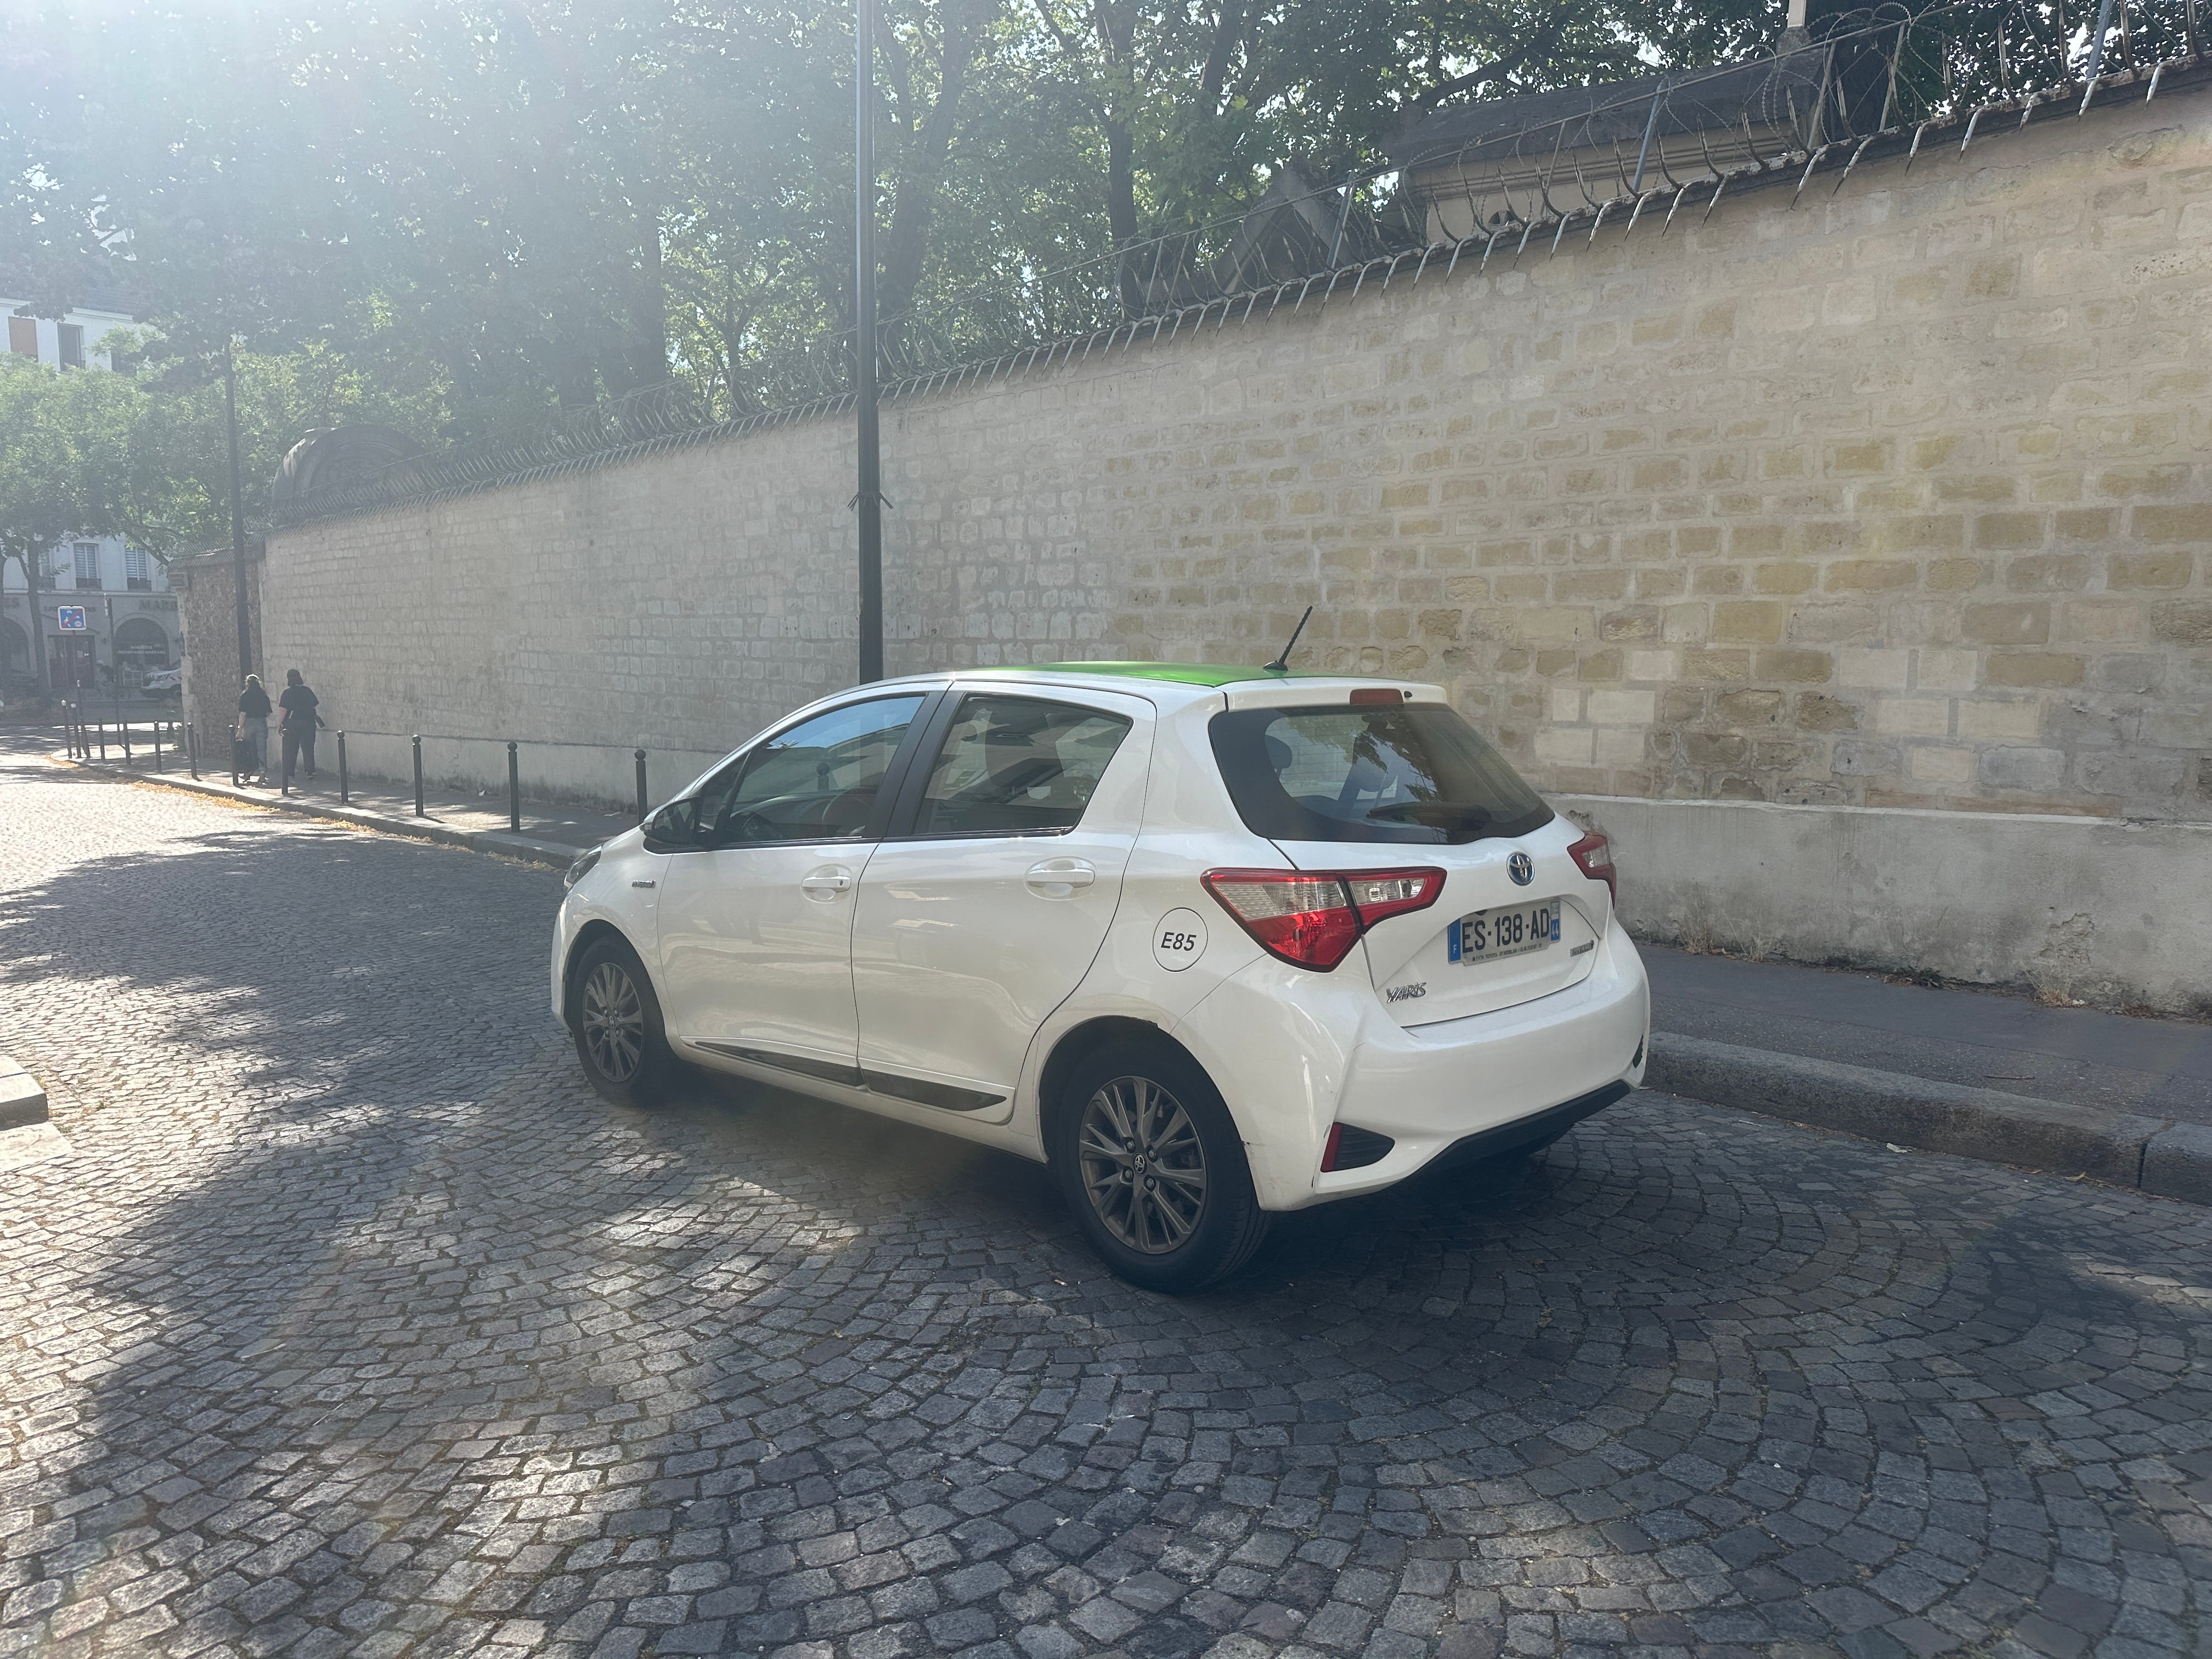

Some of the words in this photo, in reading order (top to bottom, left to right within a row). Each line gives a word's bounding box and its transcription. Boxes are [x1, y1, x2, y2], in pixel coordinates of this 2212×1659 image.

[1462, 909, 1549, 953] ES-138-AD
[1160, 932, 1197, 951] E85
[1453, 945, 1457, 954] F
